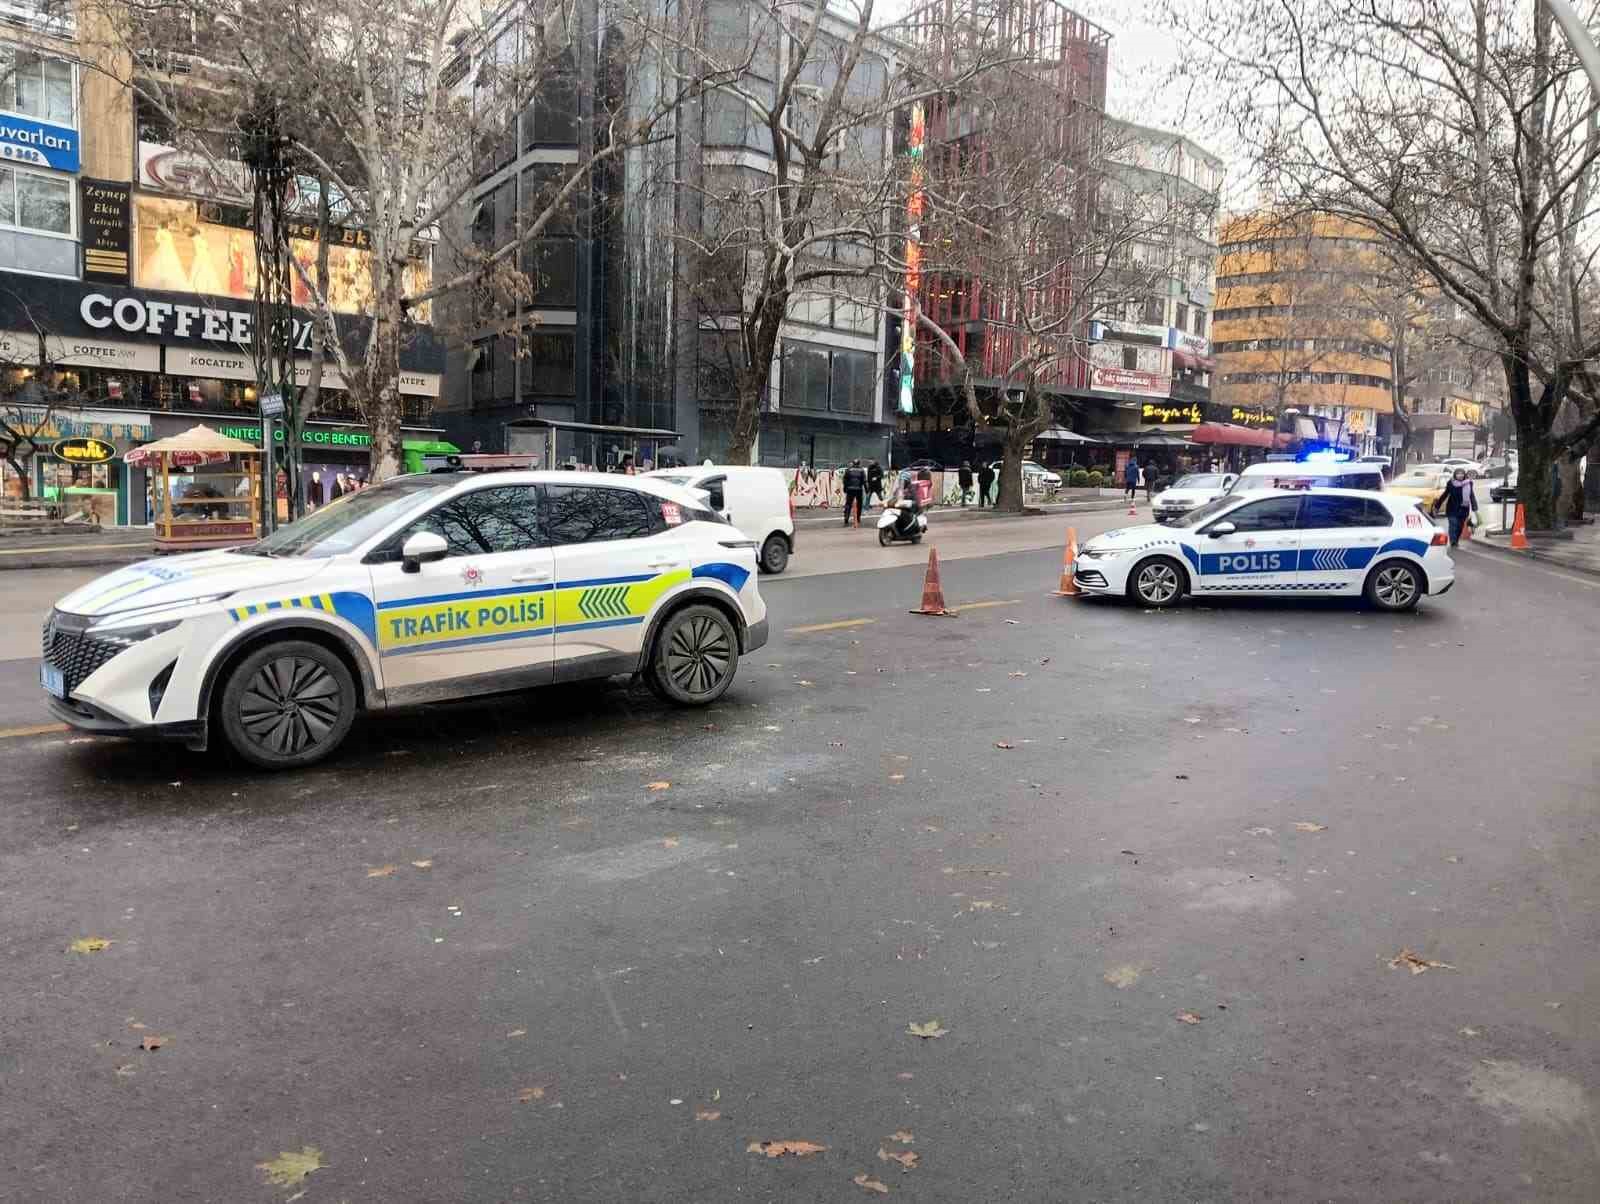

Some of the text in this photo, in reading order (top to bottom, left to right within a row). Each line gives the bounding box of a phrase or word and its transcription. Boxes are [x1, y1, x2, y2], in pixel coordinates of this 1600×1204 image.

[86, 186, 127, 201] Zeynep
[94, 203, 120, 215] Ekin
[80, 293, 254, 344] COFFEE
[73, 345, 116, 357] COFFEE
[190, 356, 245, 369] KOCATEPE
[218, 427, 262, 440] UNITED
[314, 430, 330, 443] OF
[332, 433, 371, 446] BENETT
[389, 597, 545, 640] TRAFİK POLİSİ
